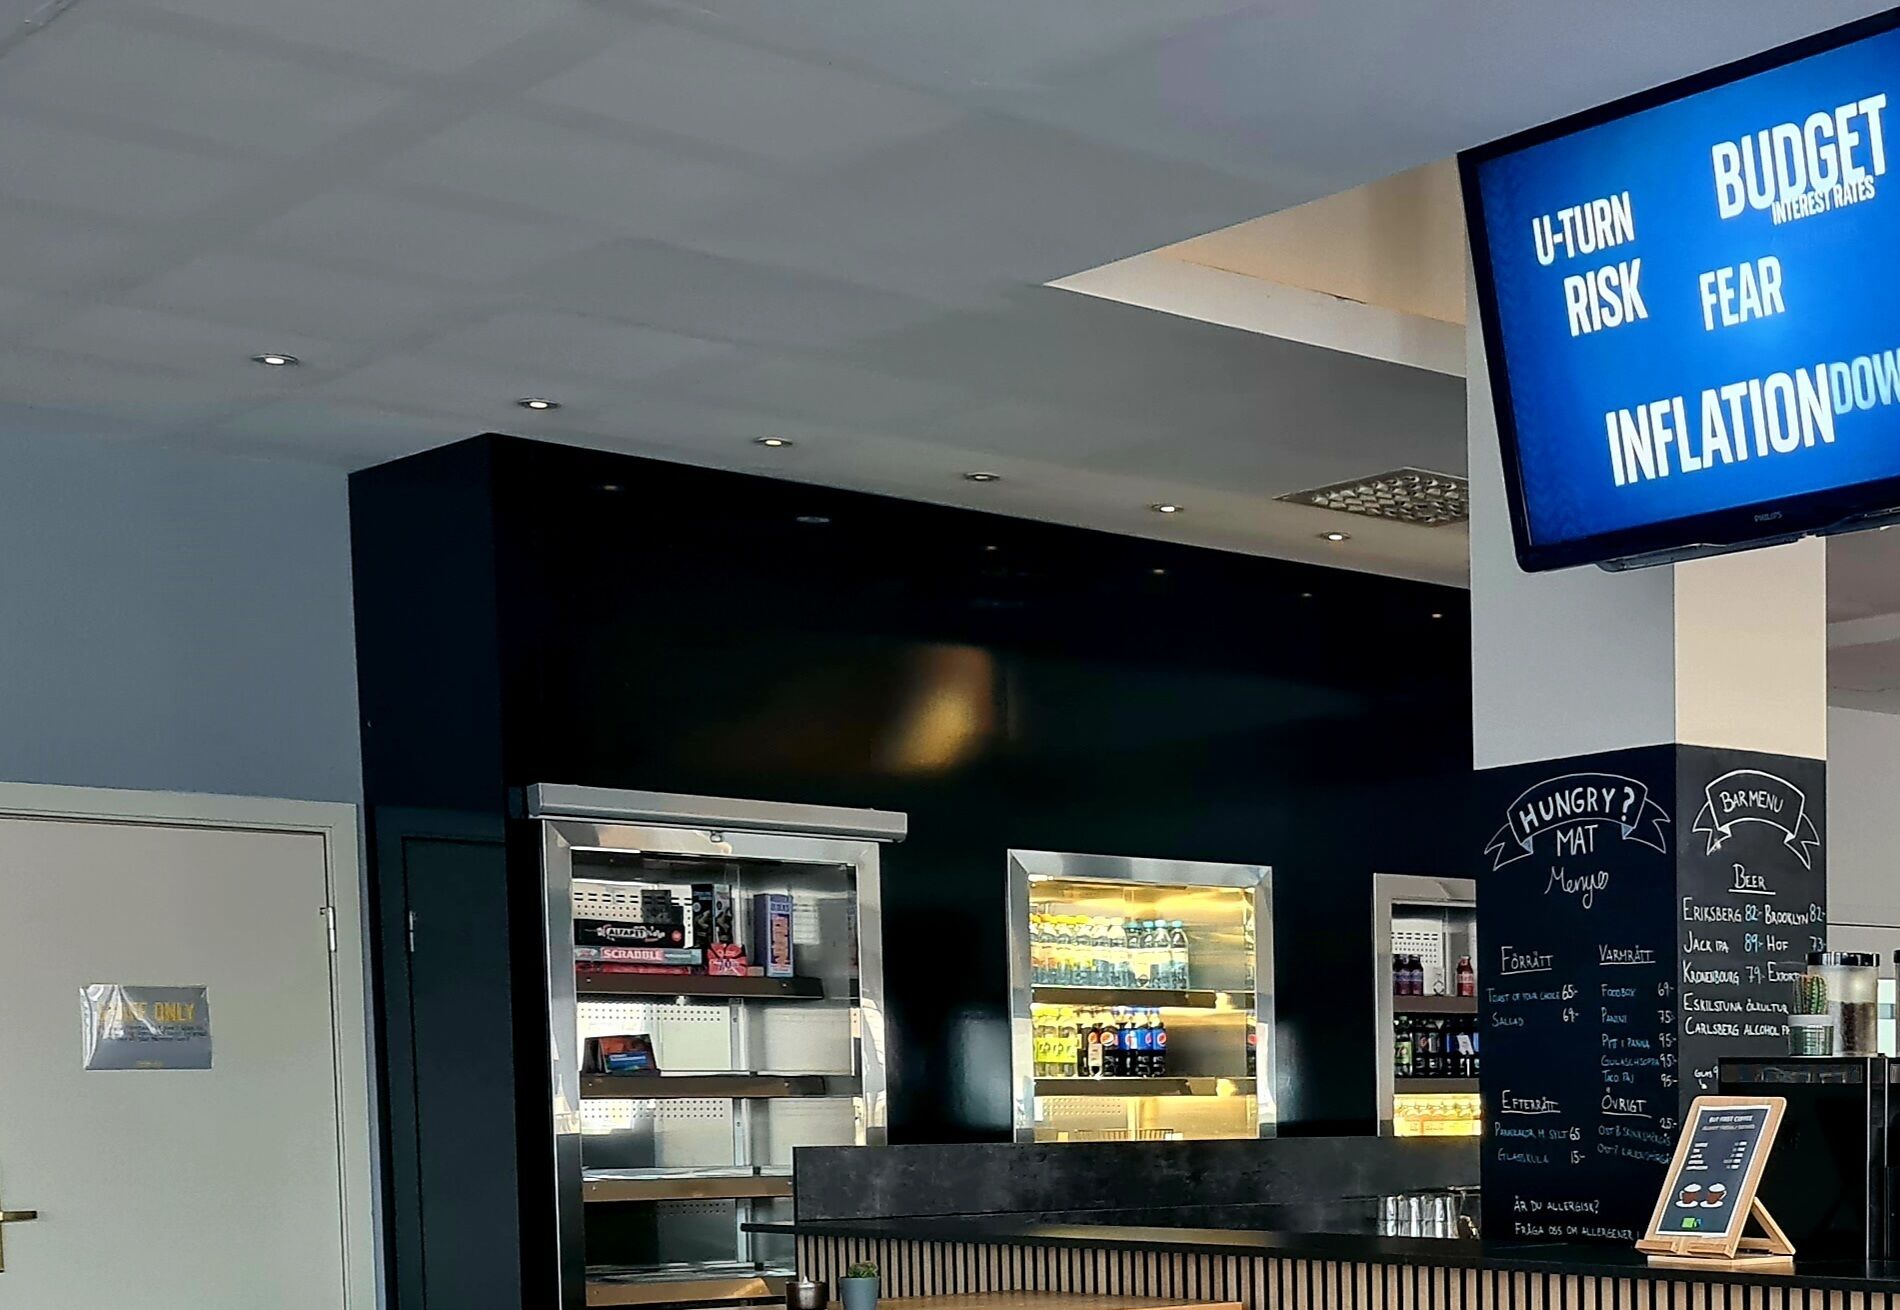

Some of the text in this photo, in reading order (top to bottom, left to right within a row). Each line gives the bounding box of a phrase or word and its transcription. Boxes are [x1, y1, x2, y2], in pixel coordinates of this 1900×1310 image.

[1712, 93, 1887, 220] BUDGET
[1532, 191, 1635, 266] U-TURN
[1772, 175, 1876, 225] INTEREST RATES
[1564, 258, 1648, 337] RISK
[1699, 255, 1785, 331] FEAR
[1605, 363, 1835, 487] INFLATION
[1557, 824, 1598, 857] MAT
